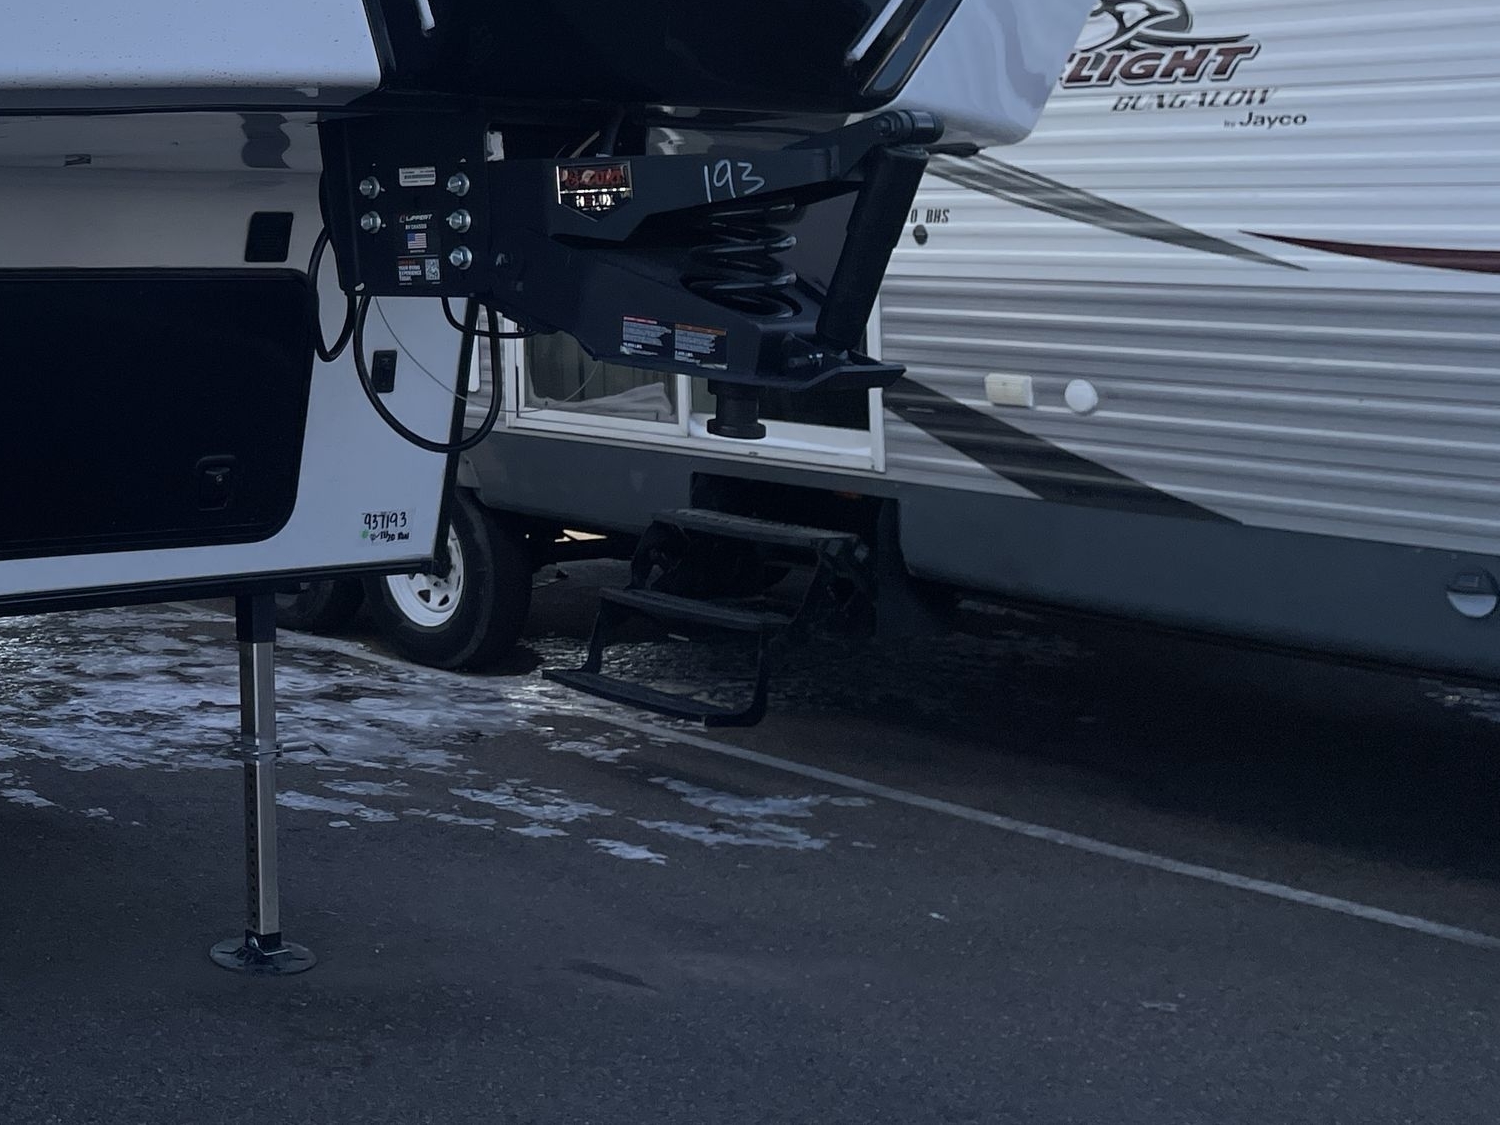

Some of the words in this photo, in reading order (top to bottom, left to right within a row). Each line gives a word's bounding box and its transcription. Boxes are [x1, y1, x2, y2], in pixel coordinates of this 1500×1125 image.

[1059, 43, 1261, 88] LIGHT
[1112, 88, 1276, 113] BUNGALOW
[1239, 112, 1308, 129] Jayco
[703, 159, 765, 203] 193
[363, 511, 408, 530] 937193
